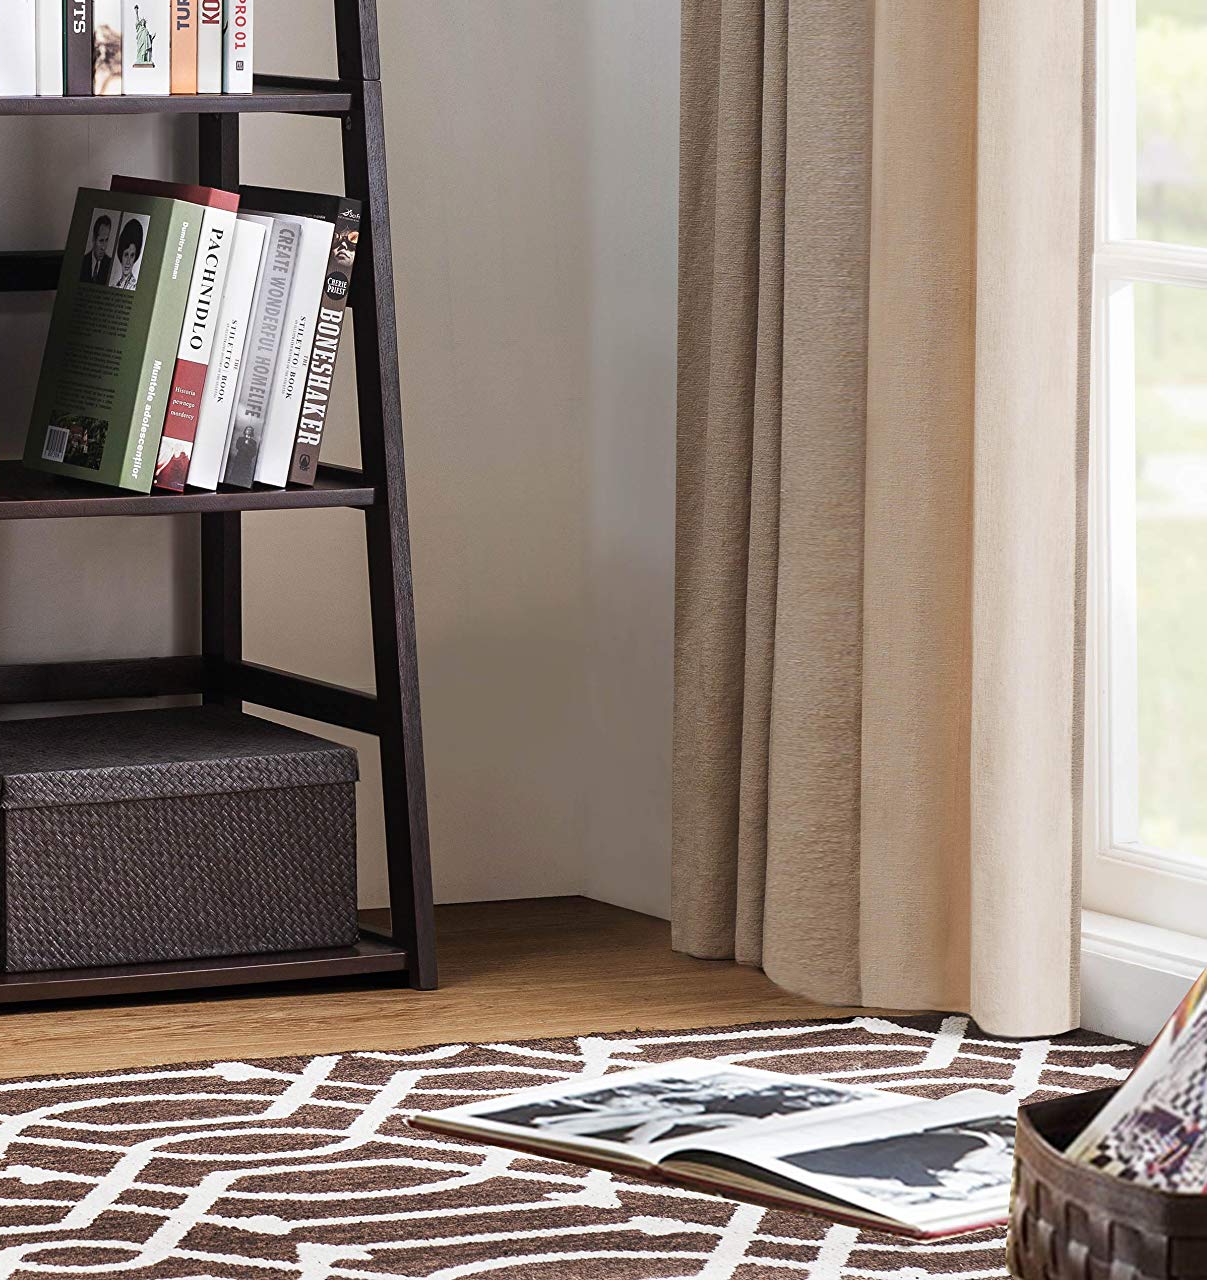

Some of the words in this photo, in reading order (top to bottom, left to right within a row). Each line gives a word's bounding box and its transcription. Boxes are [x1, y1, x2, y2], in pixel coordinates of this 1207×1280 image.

[234, 31, 246, 50] 01
[176, 221, 189, 252] Dumitru
[273, 227, 295, 273] CREATE
[172, 251, 183, 280] Roman
[189, 227, 224, 351] PACHNIDLO
[326, 284, 347, 296] PRIEST
[256, 274, 285, 355] WONDERFUL
[223, 319, 238, 370] STILETTO
[292, 316, 306, 368] STILETTO
[147, 360, 163, 401] Muntele
[215, 375, 228, 403] BOOK
[244, 354, 272, 419] HOMELIFE
[285, 372, 297, 400] BOOK
[297, 306, 343, 446] BONESHAKER
